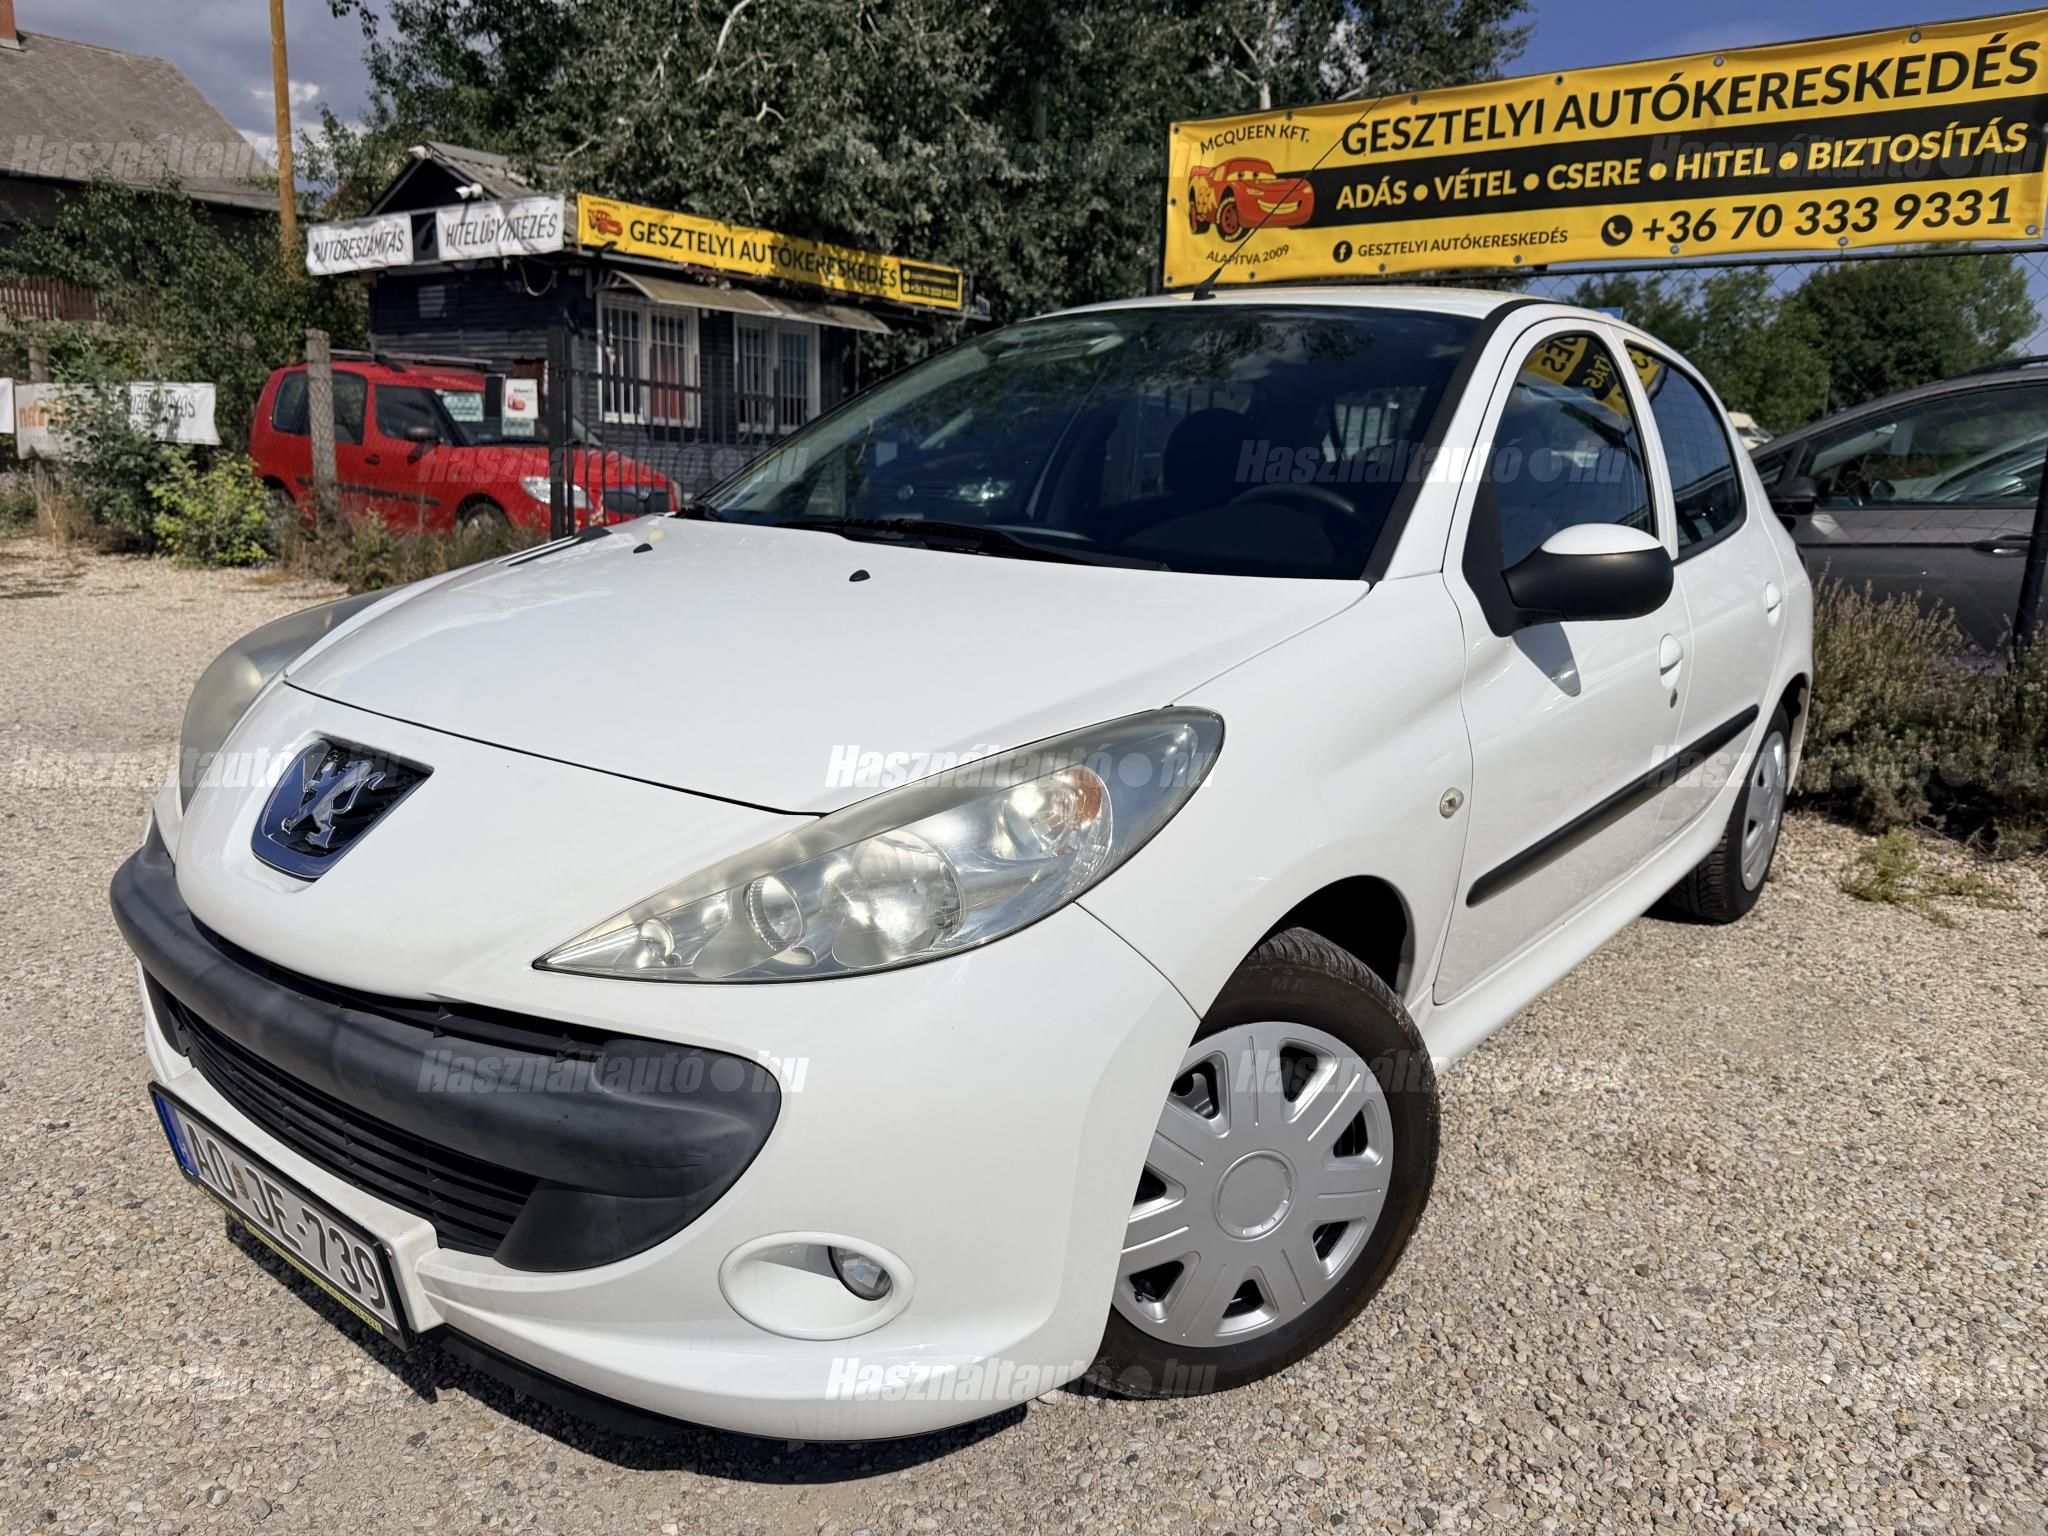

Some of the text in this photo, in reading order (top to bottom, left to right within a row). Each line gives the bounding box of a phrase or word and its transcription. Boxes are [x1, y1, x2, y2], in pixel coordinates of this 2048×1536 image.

[1341, 32, 2041, 156] GESZTELYI AUTÓKERESKEDÉS
[1200, 124, 1310, 154] MCQUEEN KFT.
[1335, 116, 2029, 210] ADÁS VÉTEL CSERE HITEL BIZTOSÍTÁS
[1358, 227, 1569, 257] GESZTELYI AUTÓKERESKEDÉS
[1642, 187, 2013, 244] +36 70 333 9331
[630, 219, 898, 288] GESZTELYI AUTÓKERESKEDÉS
[1206, 244, 1290, 265] ALAPÍTVA 2009
[187, 1122, 238, 1199] AO
[245, 1165, 387, 1310] JE-739
